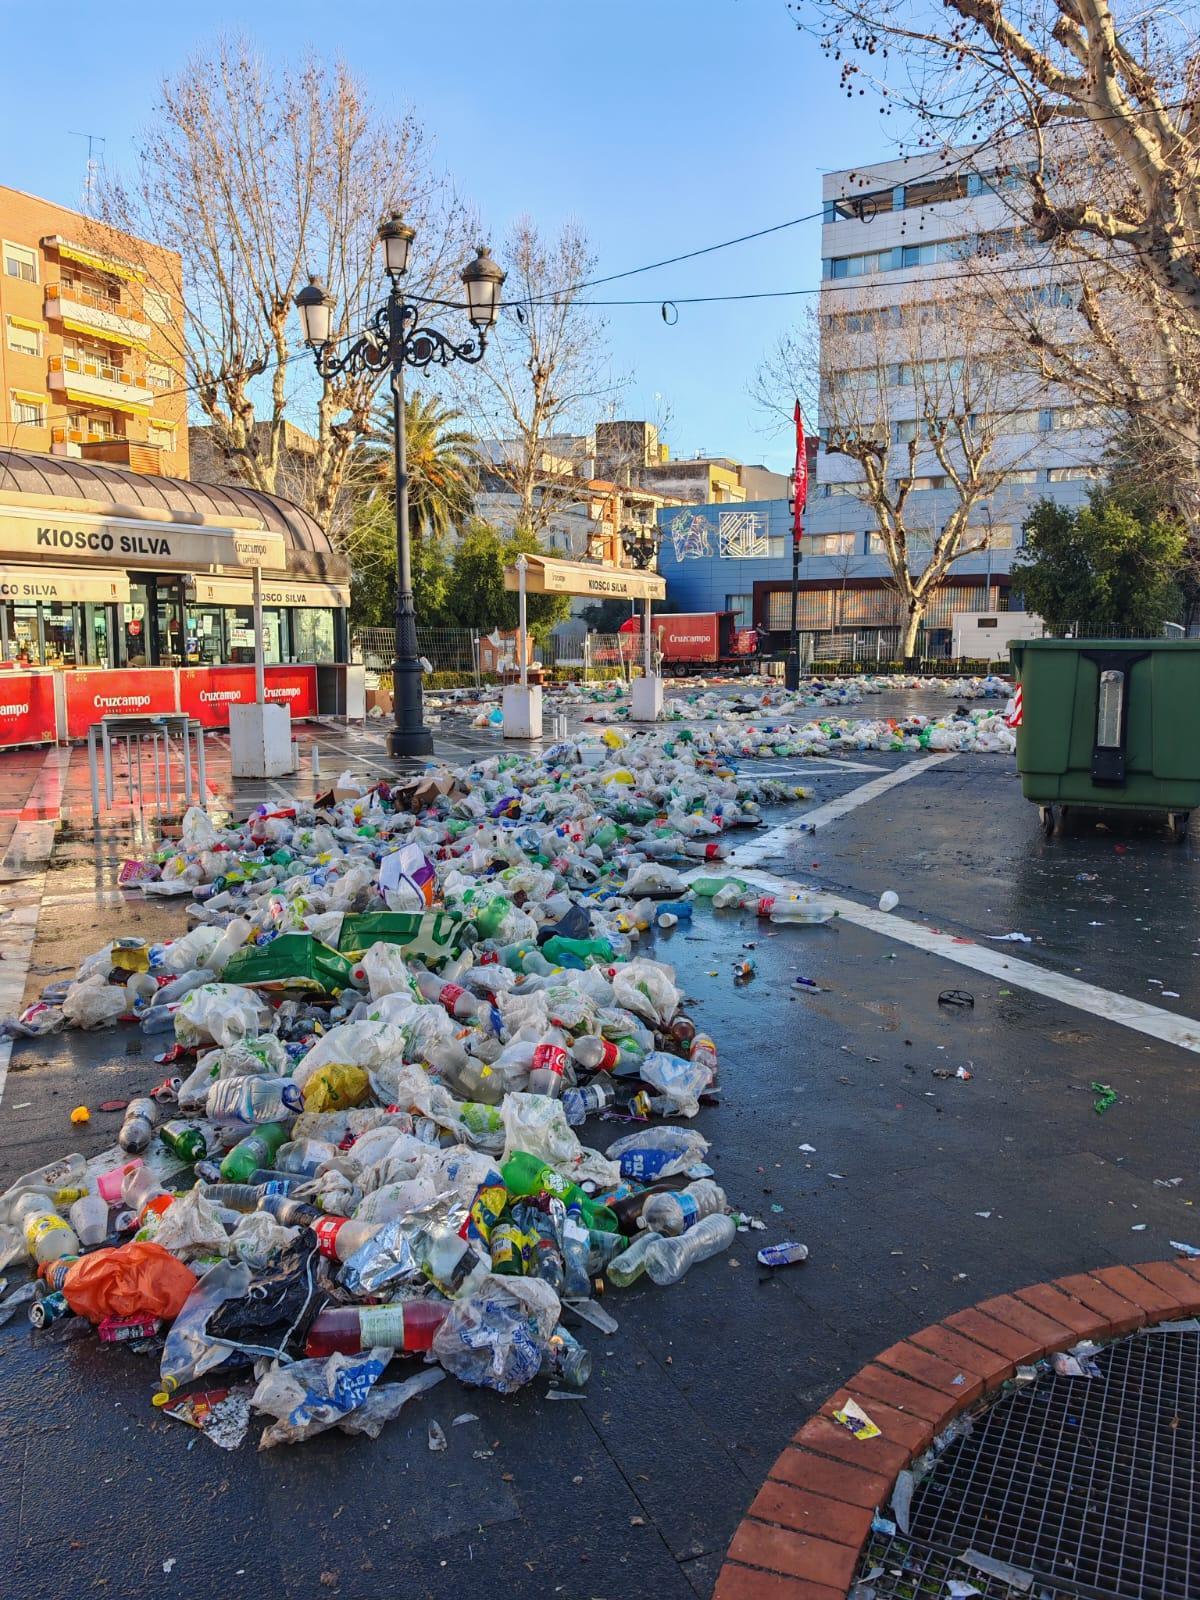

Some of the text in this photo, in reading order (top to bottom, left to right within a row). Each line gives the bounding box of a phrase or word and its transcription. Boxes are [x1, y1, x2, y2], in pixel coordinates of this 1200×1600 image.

[37, 527, 171, 555] KIOSCO SILVA
[235, 540, 267, 556] Cruzcampo
[23, 585, 57, 596] SILVA
[588, 579, 627, 592] KIOSCO SILVA
[285, 594, 307, 603] SILVA
[669, 634, 711, 644] Cruzcampo
[200, 689, 241, 702] Cruzcampo
[264, 687, 301, 698] Cruzcampo
[94, 694, 151, 708] Cruzcampo
